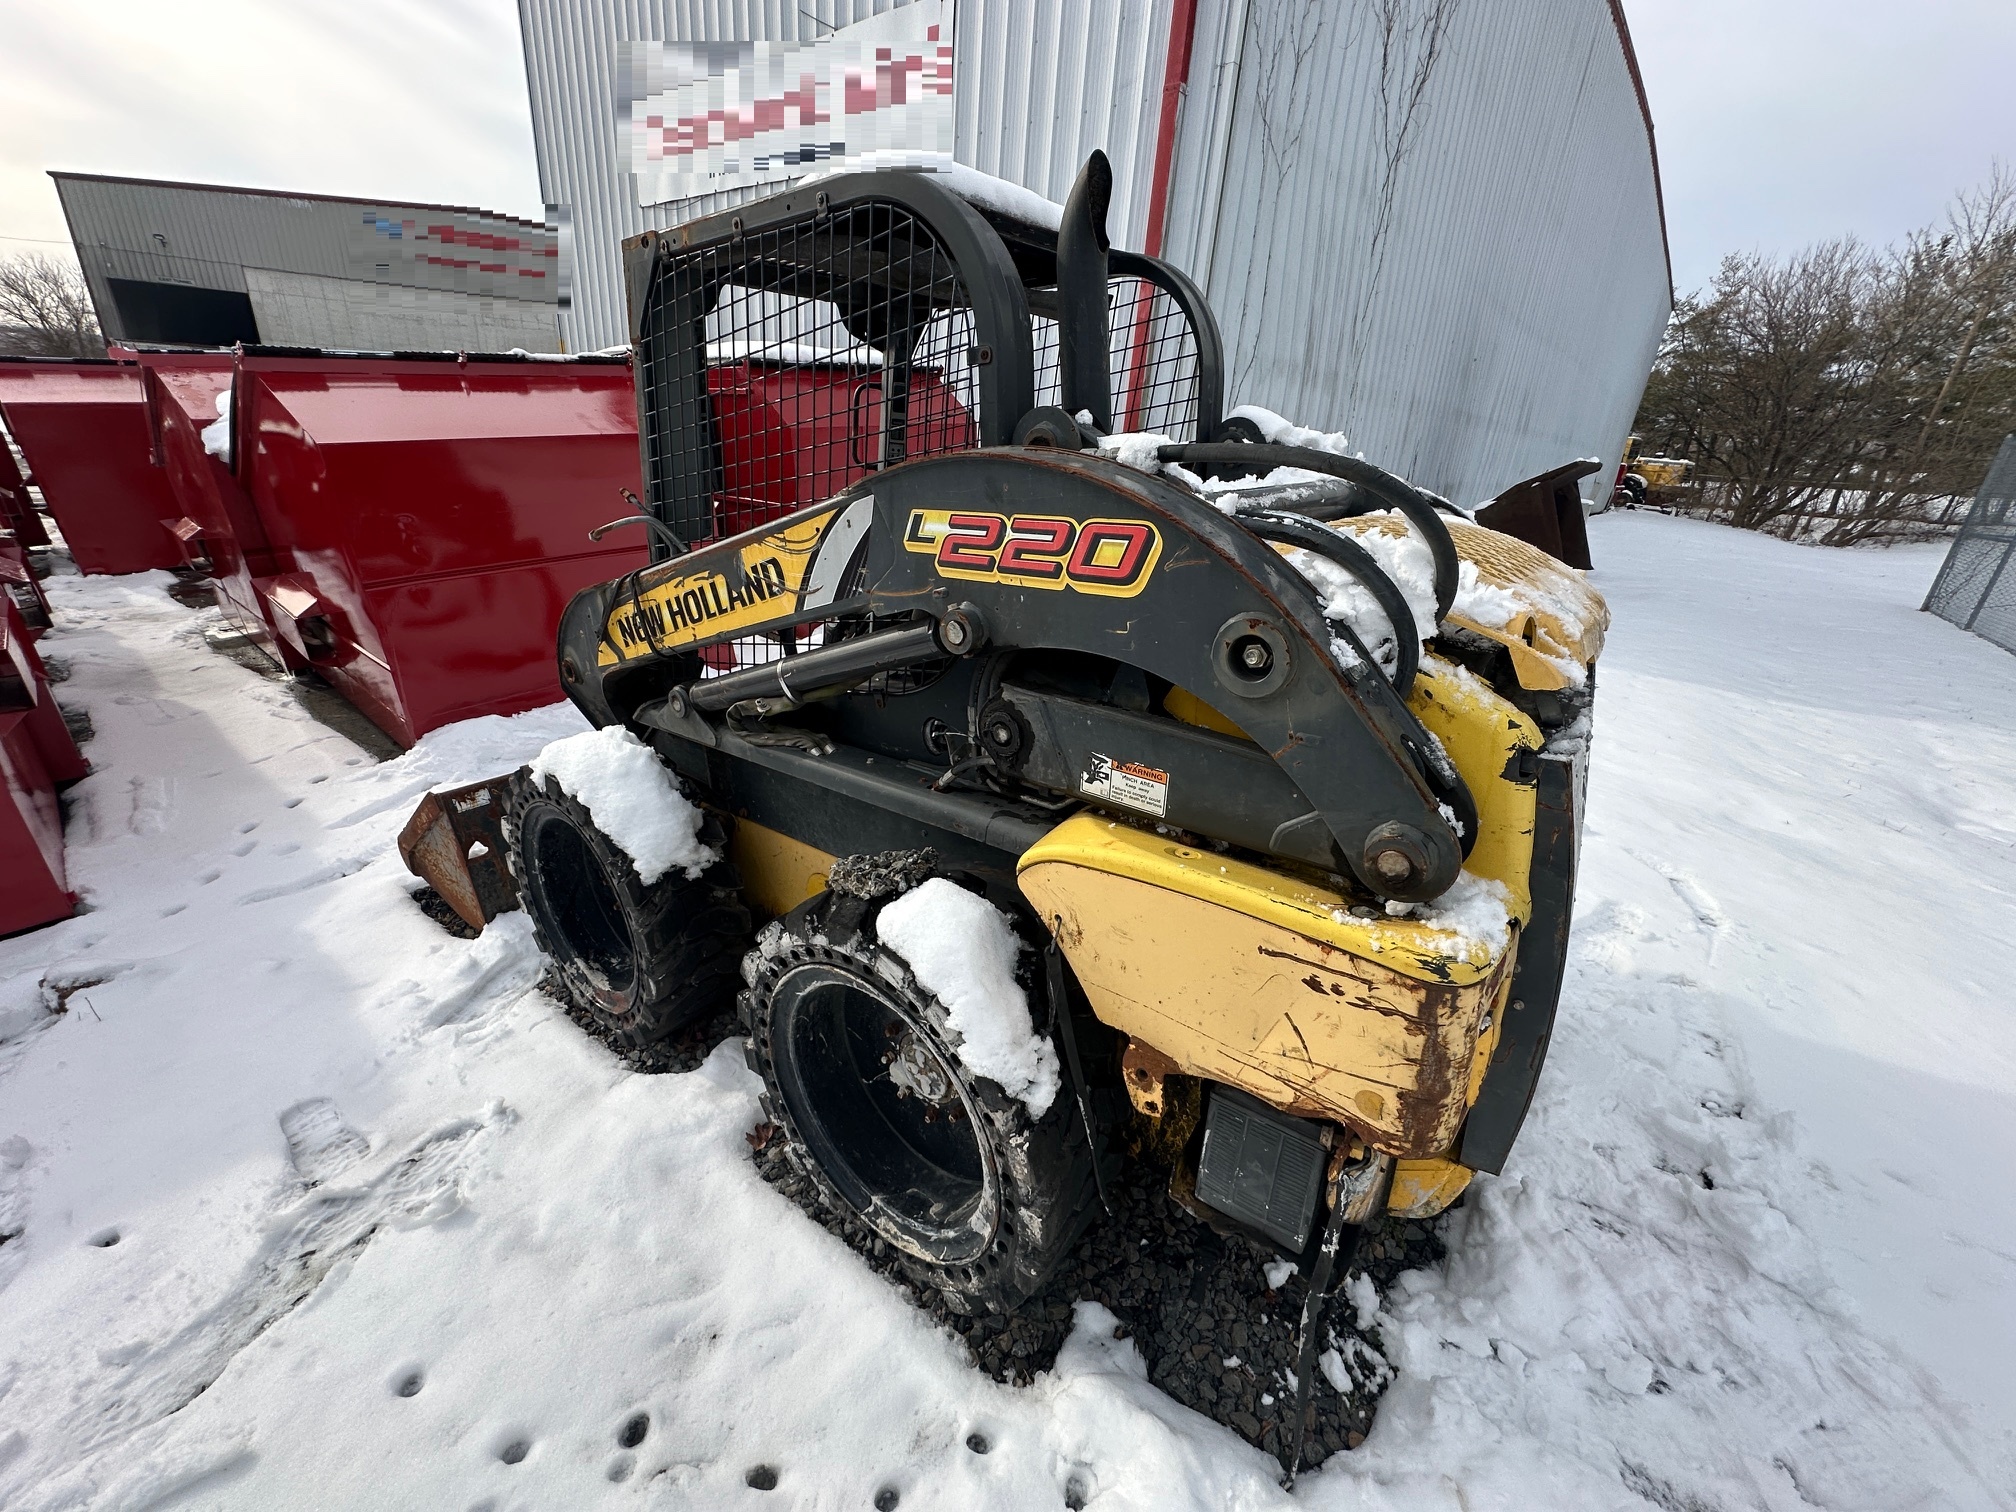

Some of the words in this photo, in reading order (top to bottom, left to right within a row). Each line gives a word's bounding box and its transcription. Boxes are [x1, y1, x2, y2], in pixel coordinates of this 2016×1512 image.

[905, 510, 1161, 590] L220
[616, 602, 666, 648] NEW
[666, 556, 786, 632] HOLLAND
[1125, 764, 1163, 781] WARNING
[1112, 784, 1126, 793] Failure
[1132, 791, 1148, 800] comply
[1140, 780, 1155, 788] AREA
[1146, 801, 1162, 809] serious
